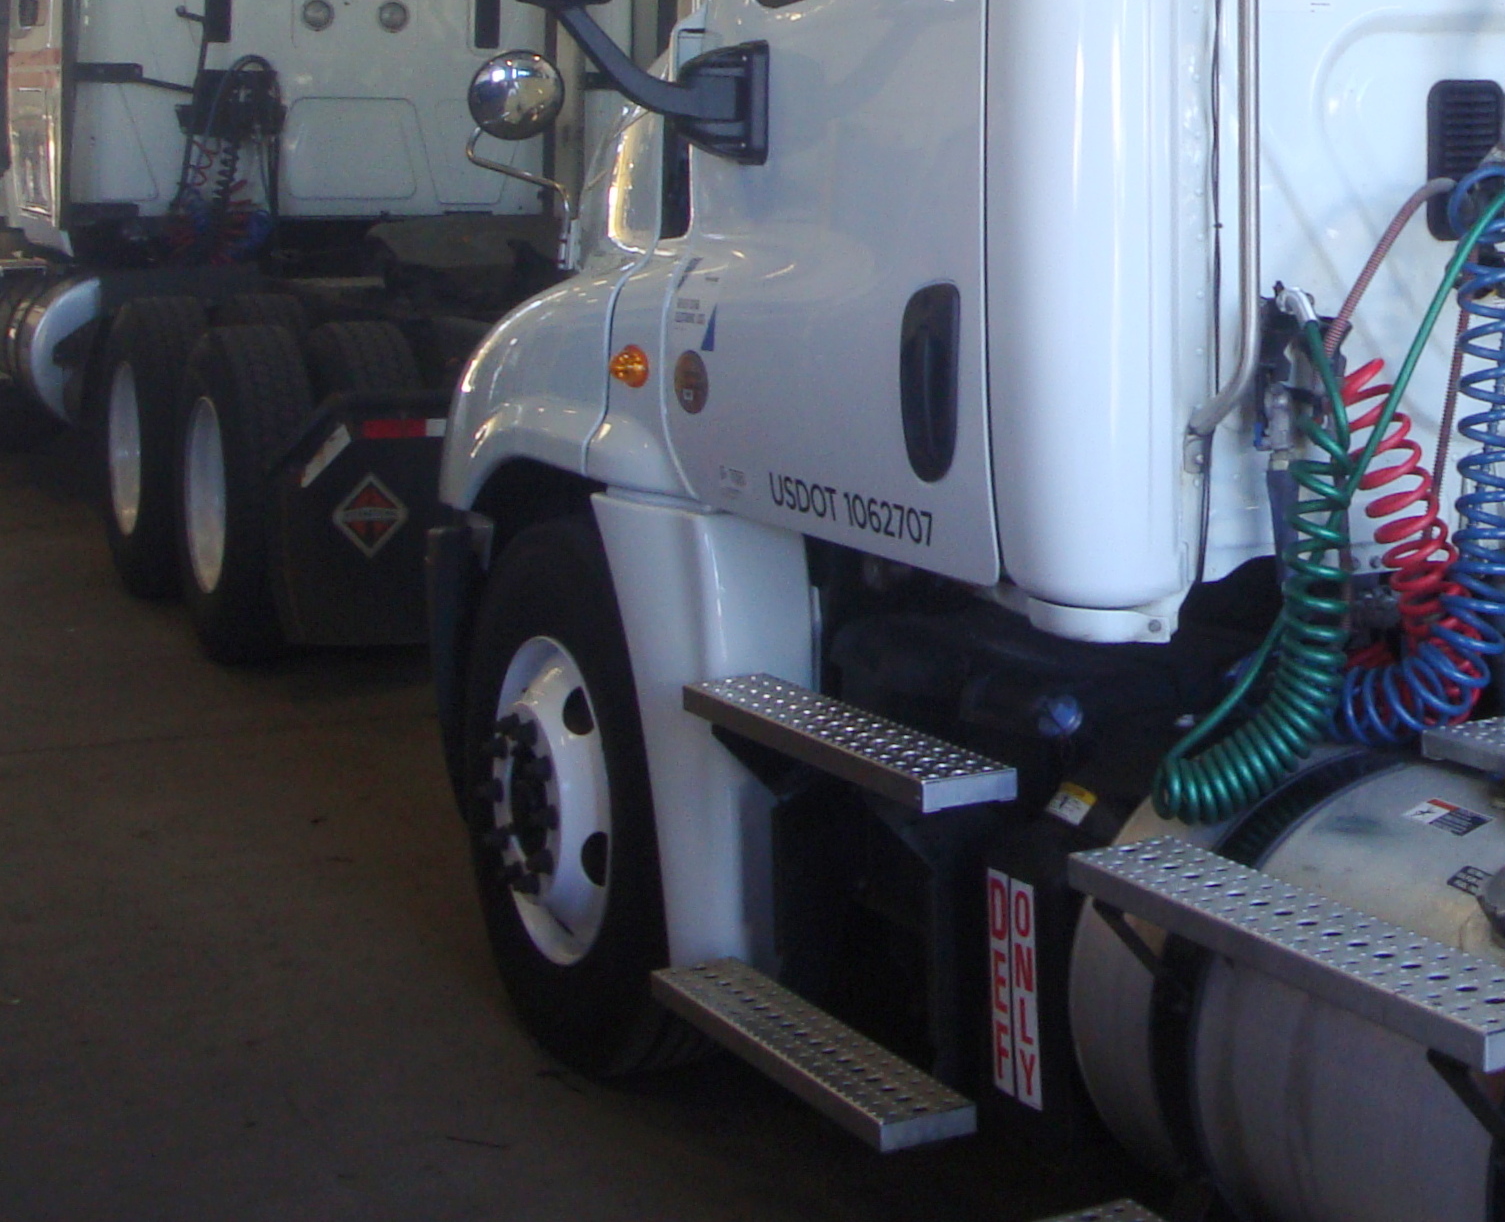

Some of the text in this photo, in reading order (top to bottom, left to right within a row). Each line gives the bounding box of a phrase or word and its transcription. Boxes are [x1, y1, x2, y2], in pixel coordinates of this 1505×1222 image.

[769, 471, 836, 521] USDOT
[843, 492, 933, 547] 1062707
[988, 876, 1009, 1080] DEF
[1014, 890, 1036, 1096] ONLY
